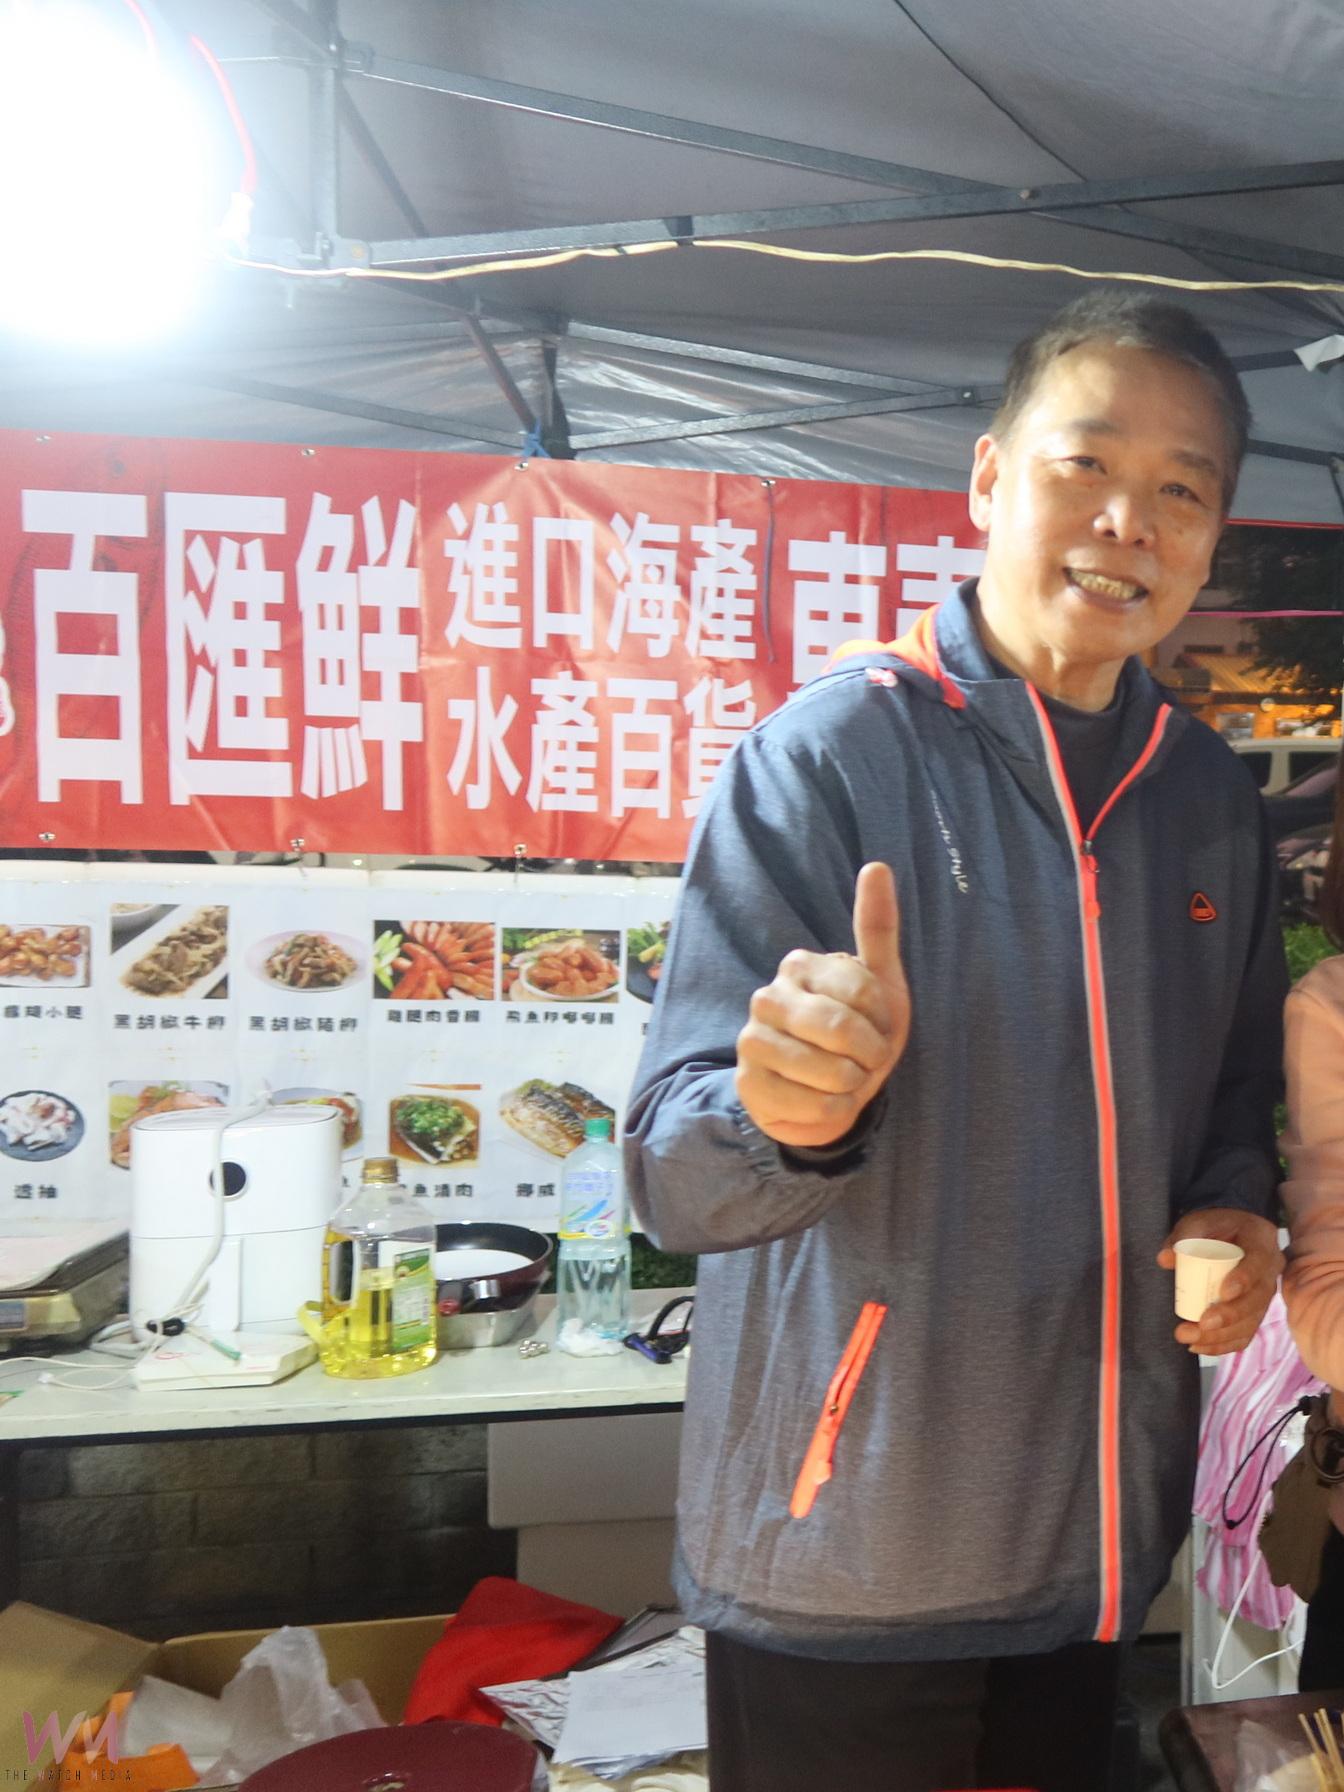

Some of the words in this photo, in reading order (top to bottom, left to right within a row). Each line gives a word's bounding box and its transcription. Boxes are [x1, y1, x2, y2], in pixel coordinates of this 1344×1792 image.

[22, 489, 423, 811] 百匯鮮
[444, 501, 758, 660] 進口海產
[447, 666, 757, 820] 水產百貨
